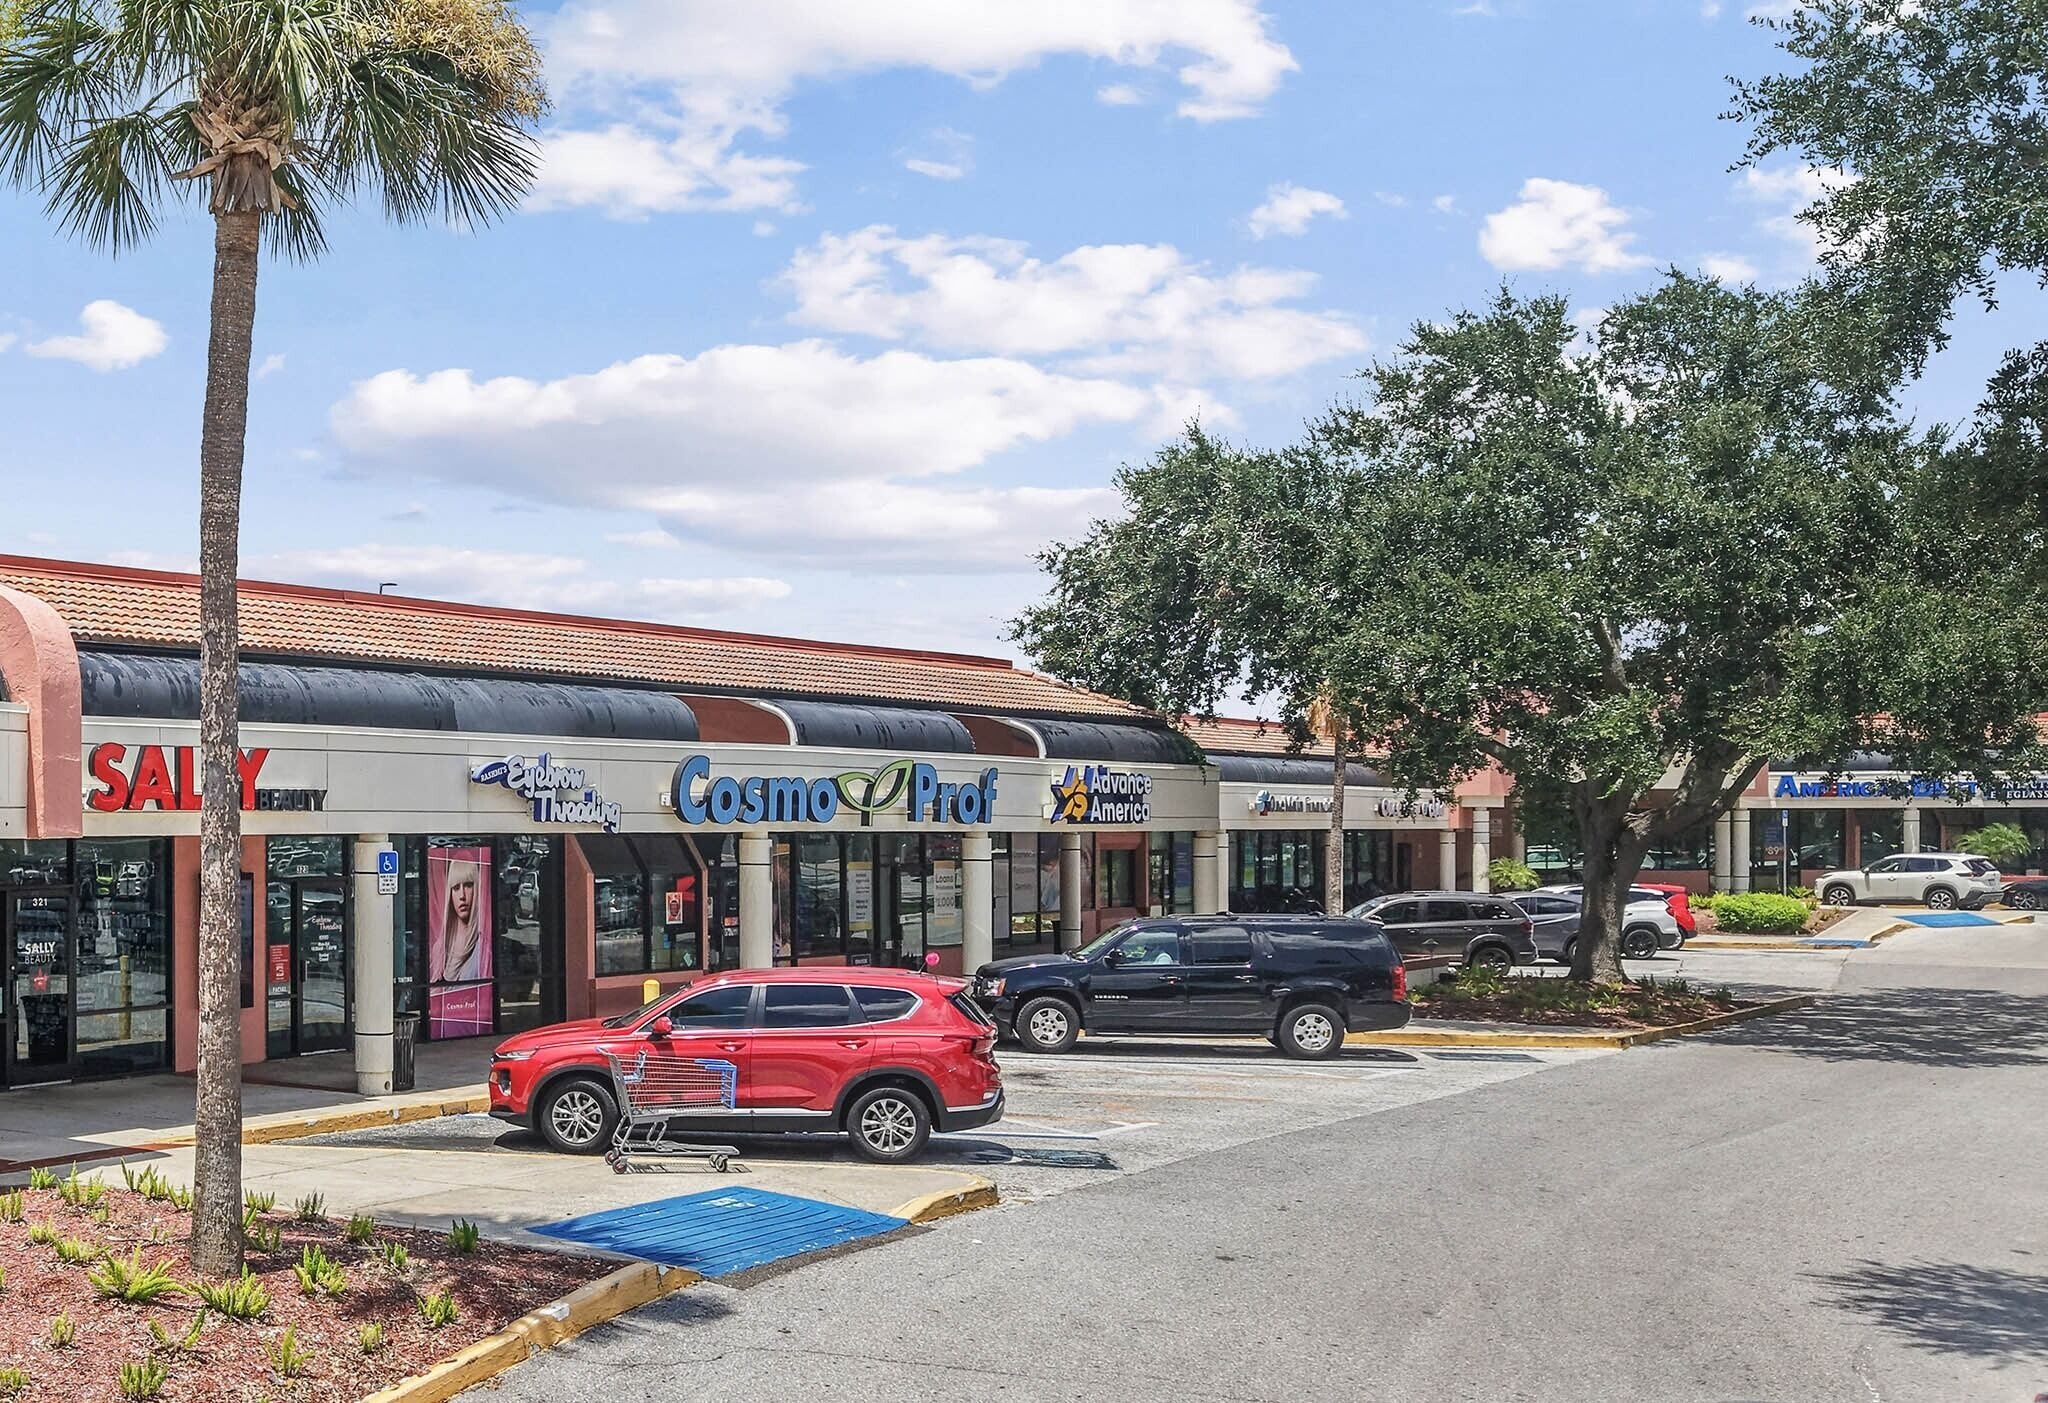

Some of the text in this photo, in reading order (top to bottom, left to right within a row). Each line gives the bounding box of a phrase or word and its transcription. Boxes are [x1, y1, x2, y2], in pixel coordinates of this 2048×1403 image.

[87, 742, 270, 812] SALY
[506, 752, 585, 798] Eyebrow
[1090, 768, 1152, 794] Advance
[259, 789, 328, 811] BEAUTY
[672, 755, 998, 825] Cosmo Prof
[533, 787, 622, 834] Threading
[1090, 795, 1150, 822] America
[32, 898, 48, 906] 321
[24, 942, 56, 954] SALLY
[24, 954, 57, 964] BEAUTY
